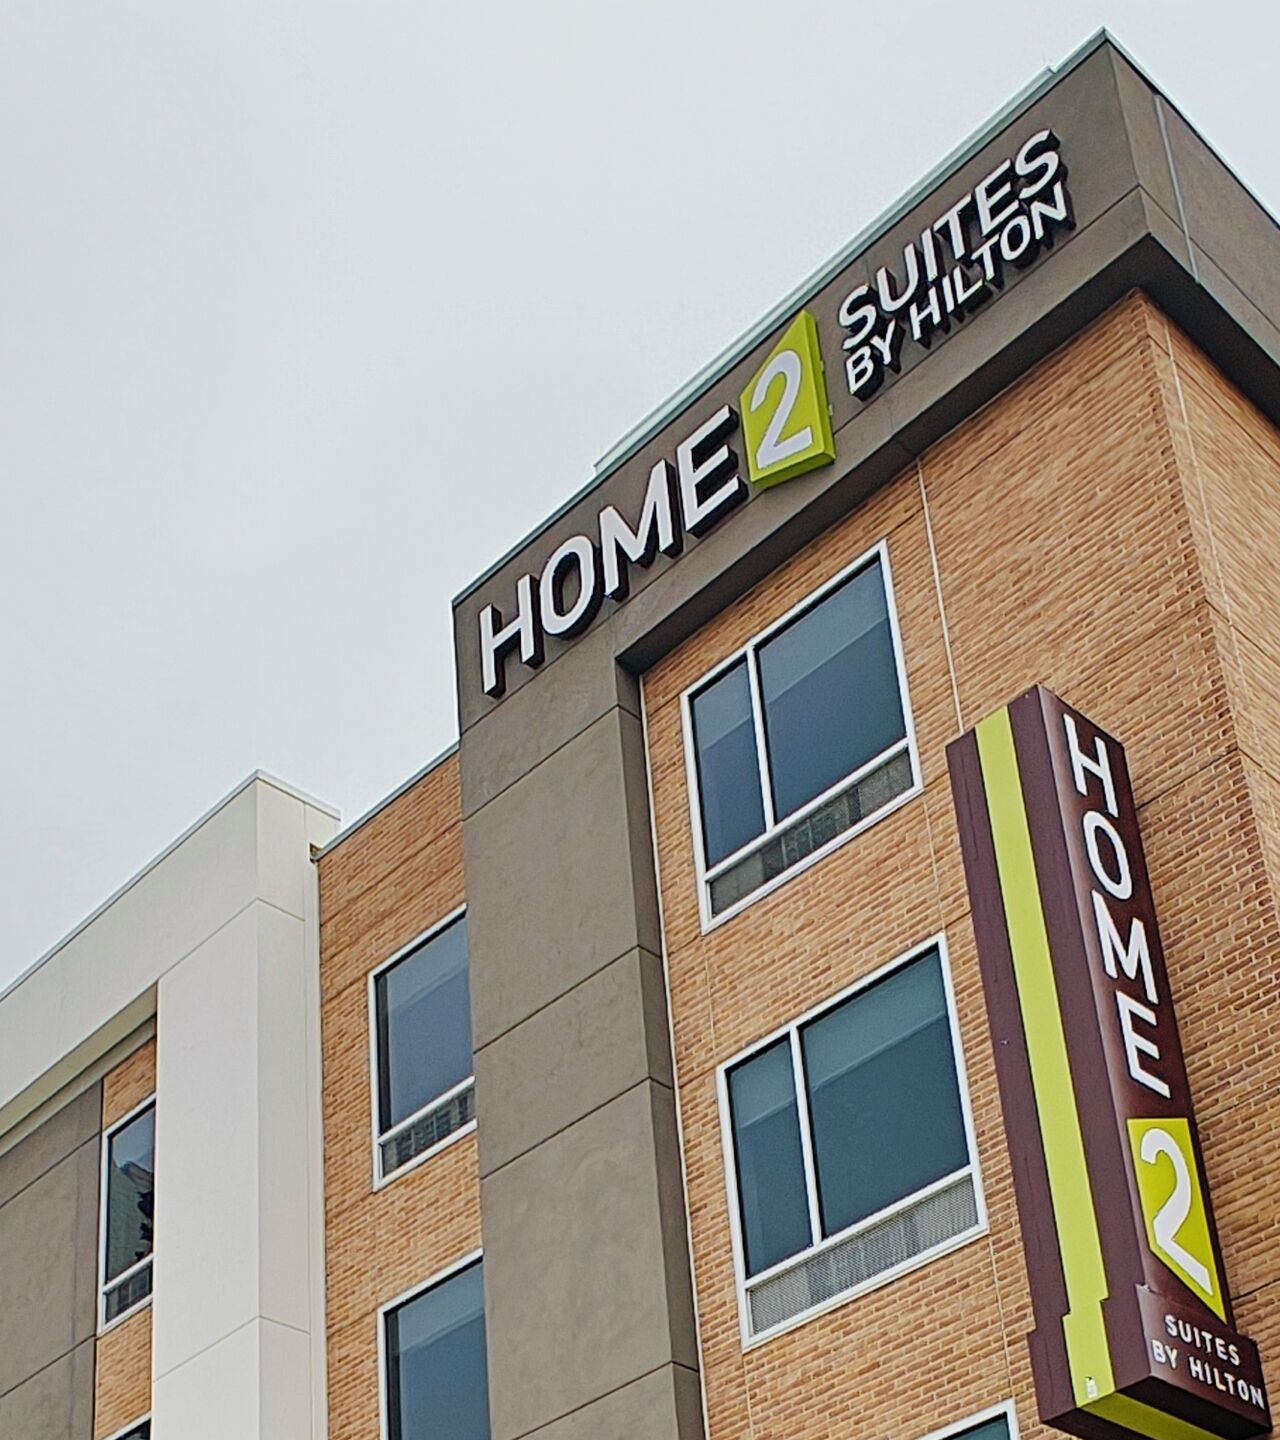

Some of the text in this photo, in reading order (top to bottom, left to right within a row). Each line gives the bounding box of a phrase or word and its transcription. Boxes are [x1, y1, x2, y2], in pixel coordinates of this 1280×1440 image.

[838, 128, 1061, 351] SUITES
[845, 181, 1068, 396] BY HILTON
[1151, 1339, 1265, 1410] BY HILTON
[1164, 1314, 1240, 1366] SUITES
